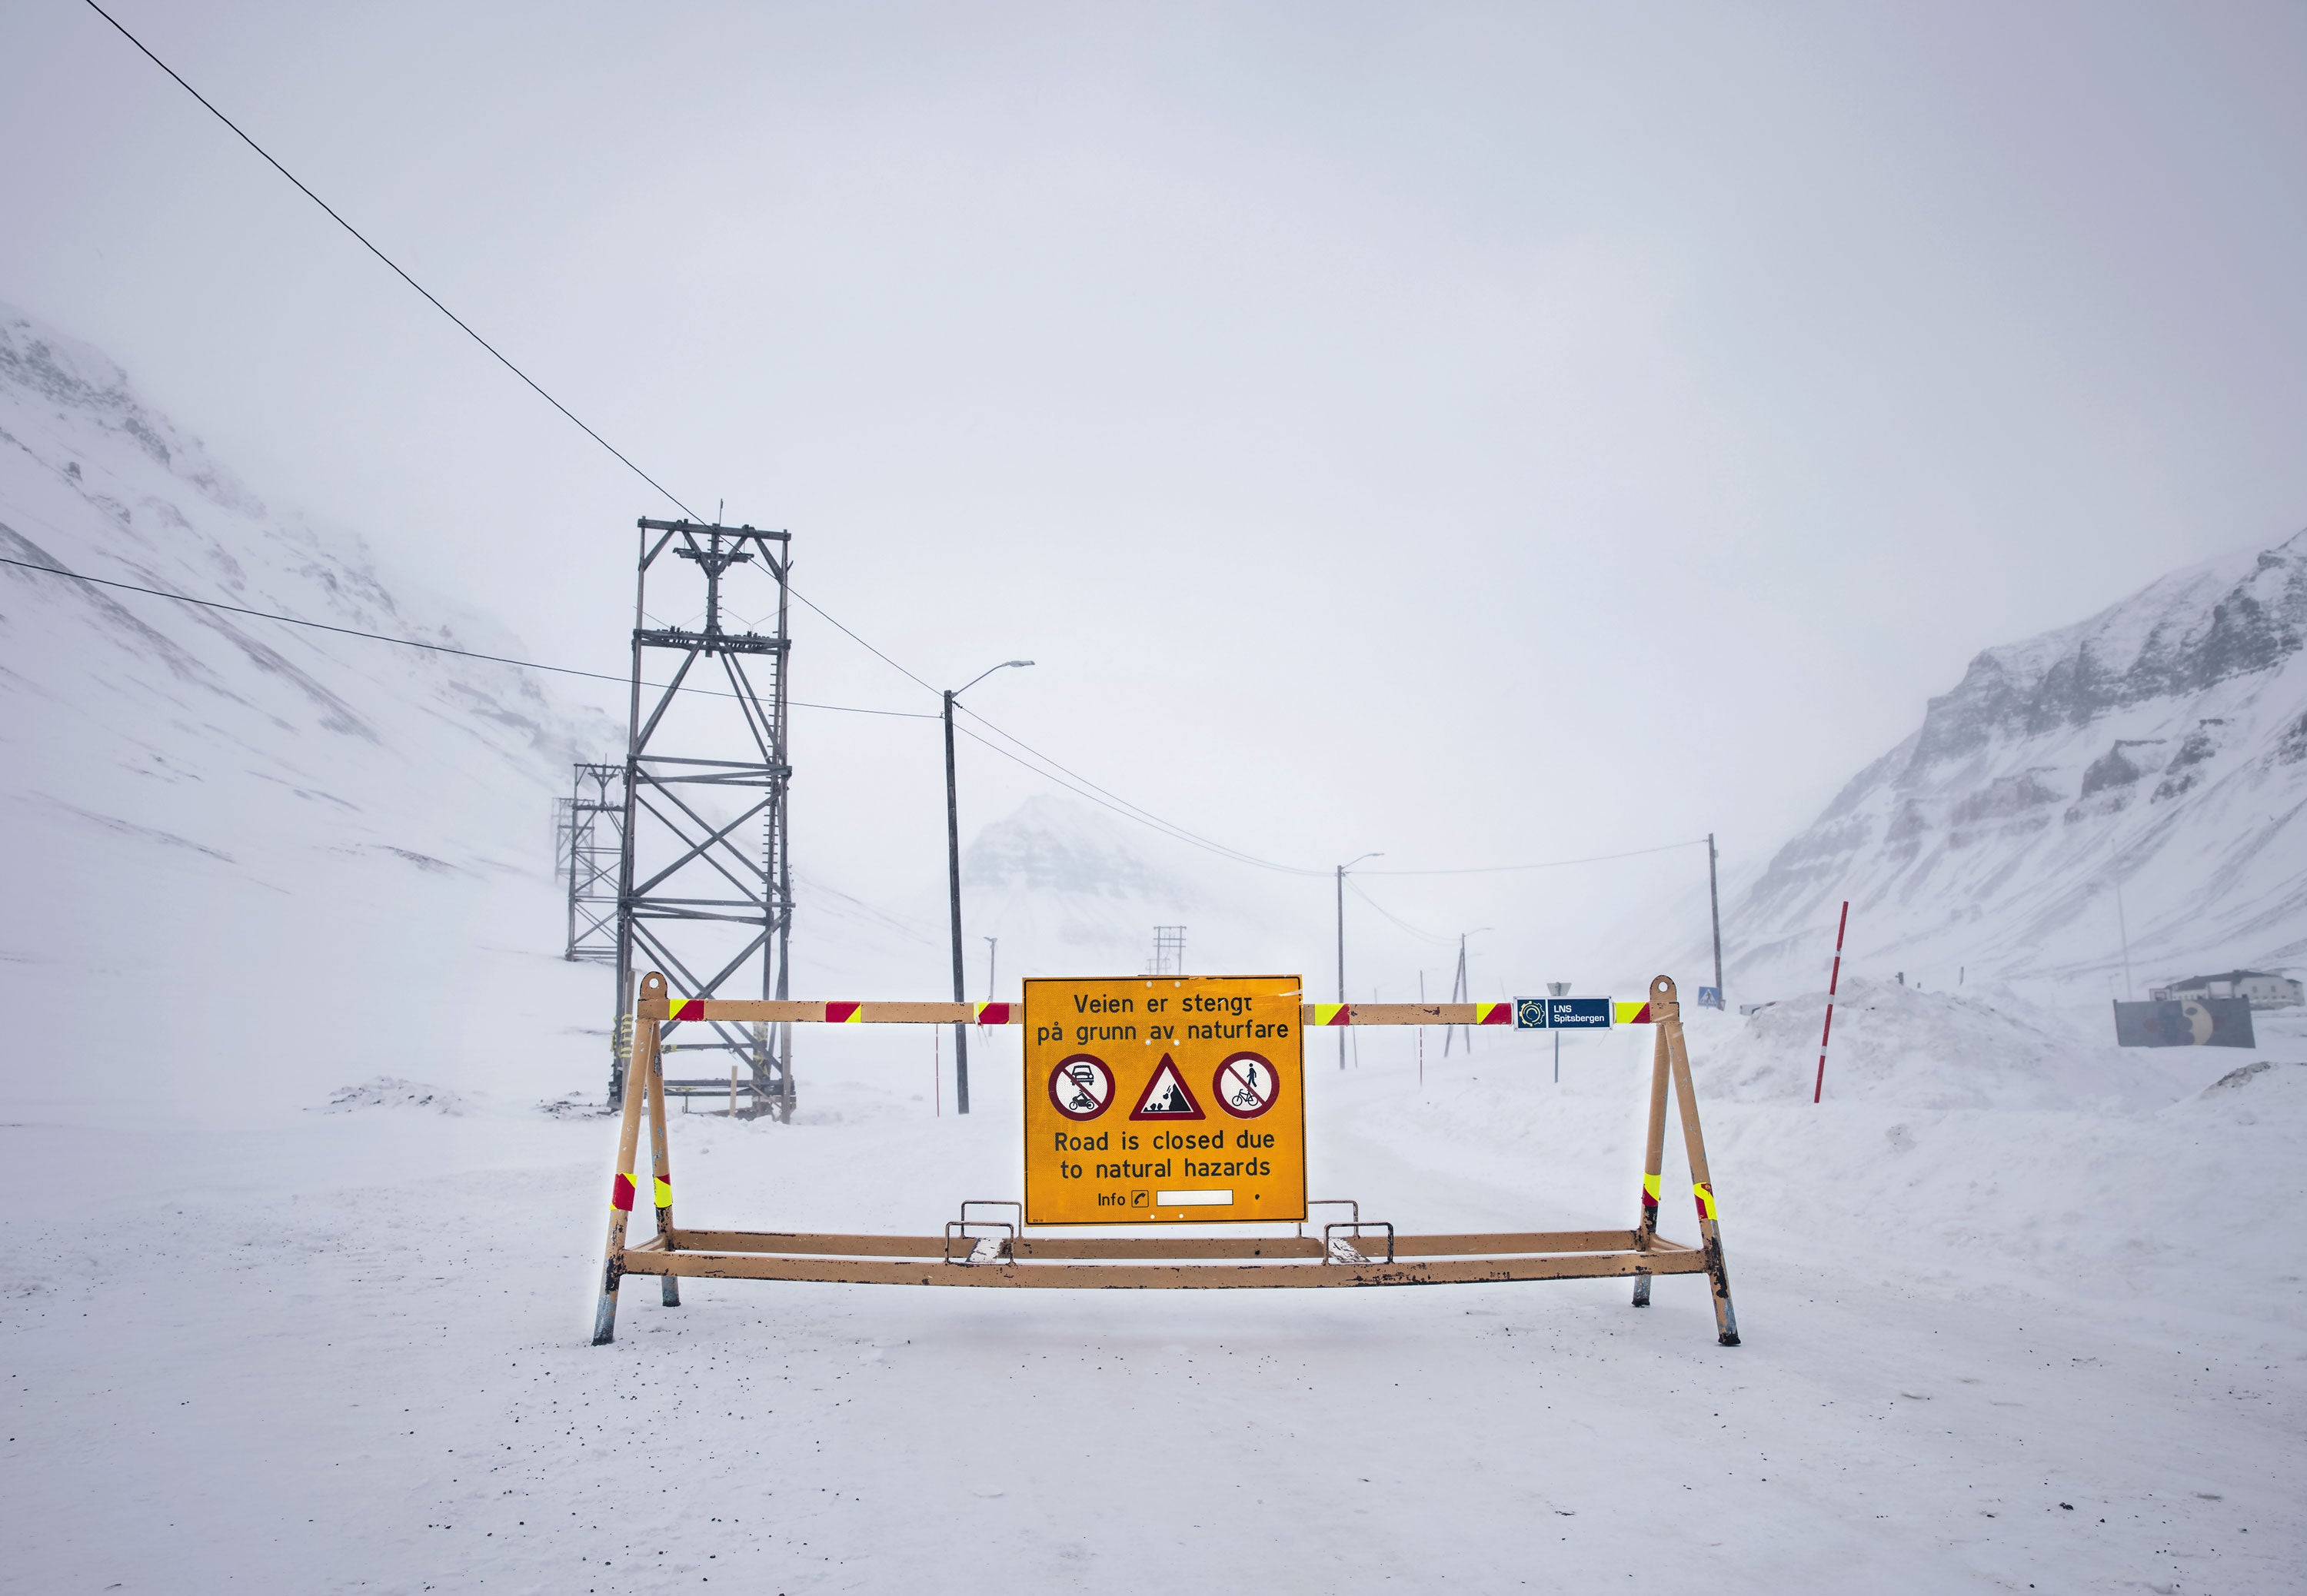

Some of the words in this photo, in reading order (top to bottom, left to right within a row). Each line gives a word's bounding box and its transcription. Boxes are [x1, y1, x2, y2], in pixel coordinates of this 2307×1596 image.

[1074, 994, 1134, 1013] Veien
[1147, 998, 1169, 1012] er
[1182, 993, 1253, 1016] stengt
[1553, 1005, 1572, 1013] LNS
[1553, 1014, 1605, 1024] Spitsbergen
[1037, 1021, 1063, 1046] på
[1076, 1026, 1137, 1046] grunn
[1150, 1025, 1175, 1039] av
[1187, 1019, 1289, 1039] naturfare
[1054, 1132, 1109, 1152] Road
[1121, 1131, 1140, 1151] is
[1153, 1129, 1223, 1150] closed
[1236, 1129, 1275, 1149] due
[1060, 1160, 1083, 1179] to
[1096, 1158, 1171, 1179] natural
[1184, 1156, 1270, 1177] hazards
[1097, 1192, 1126, 1206] Info
